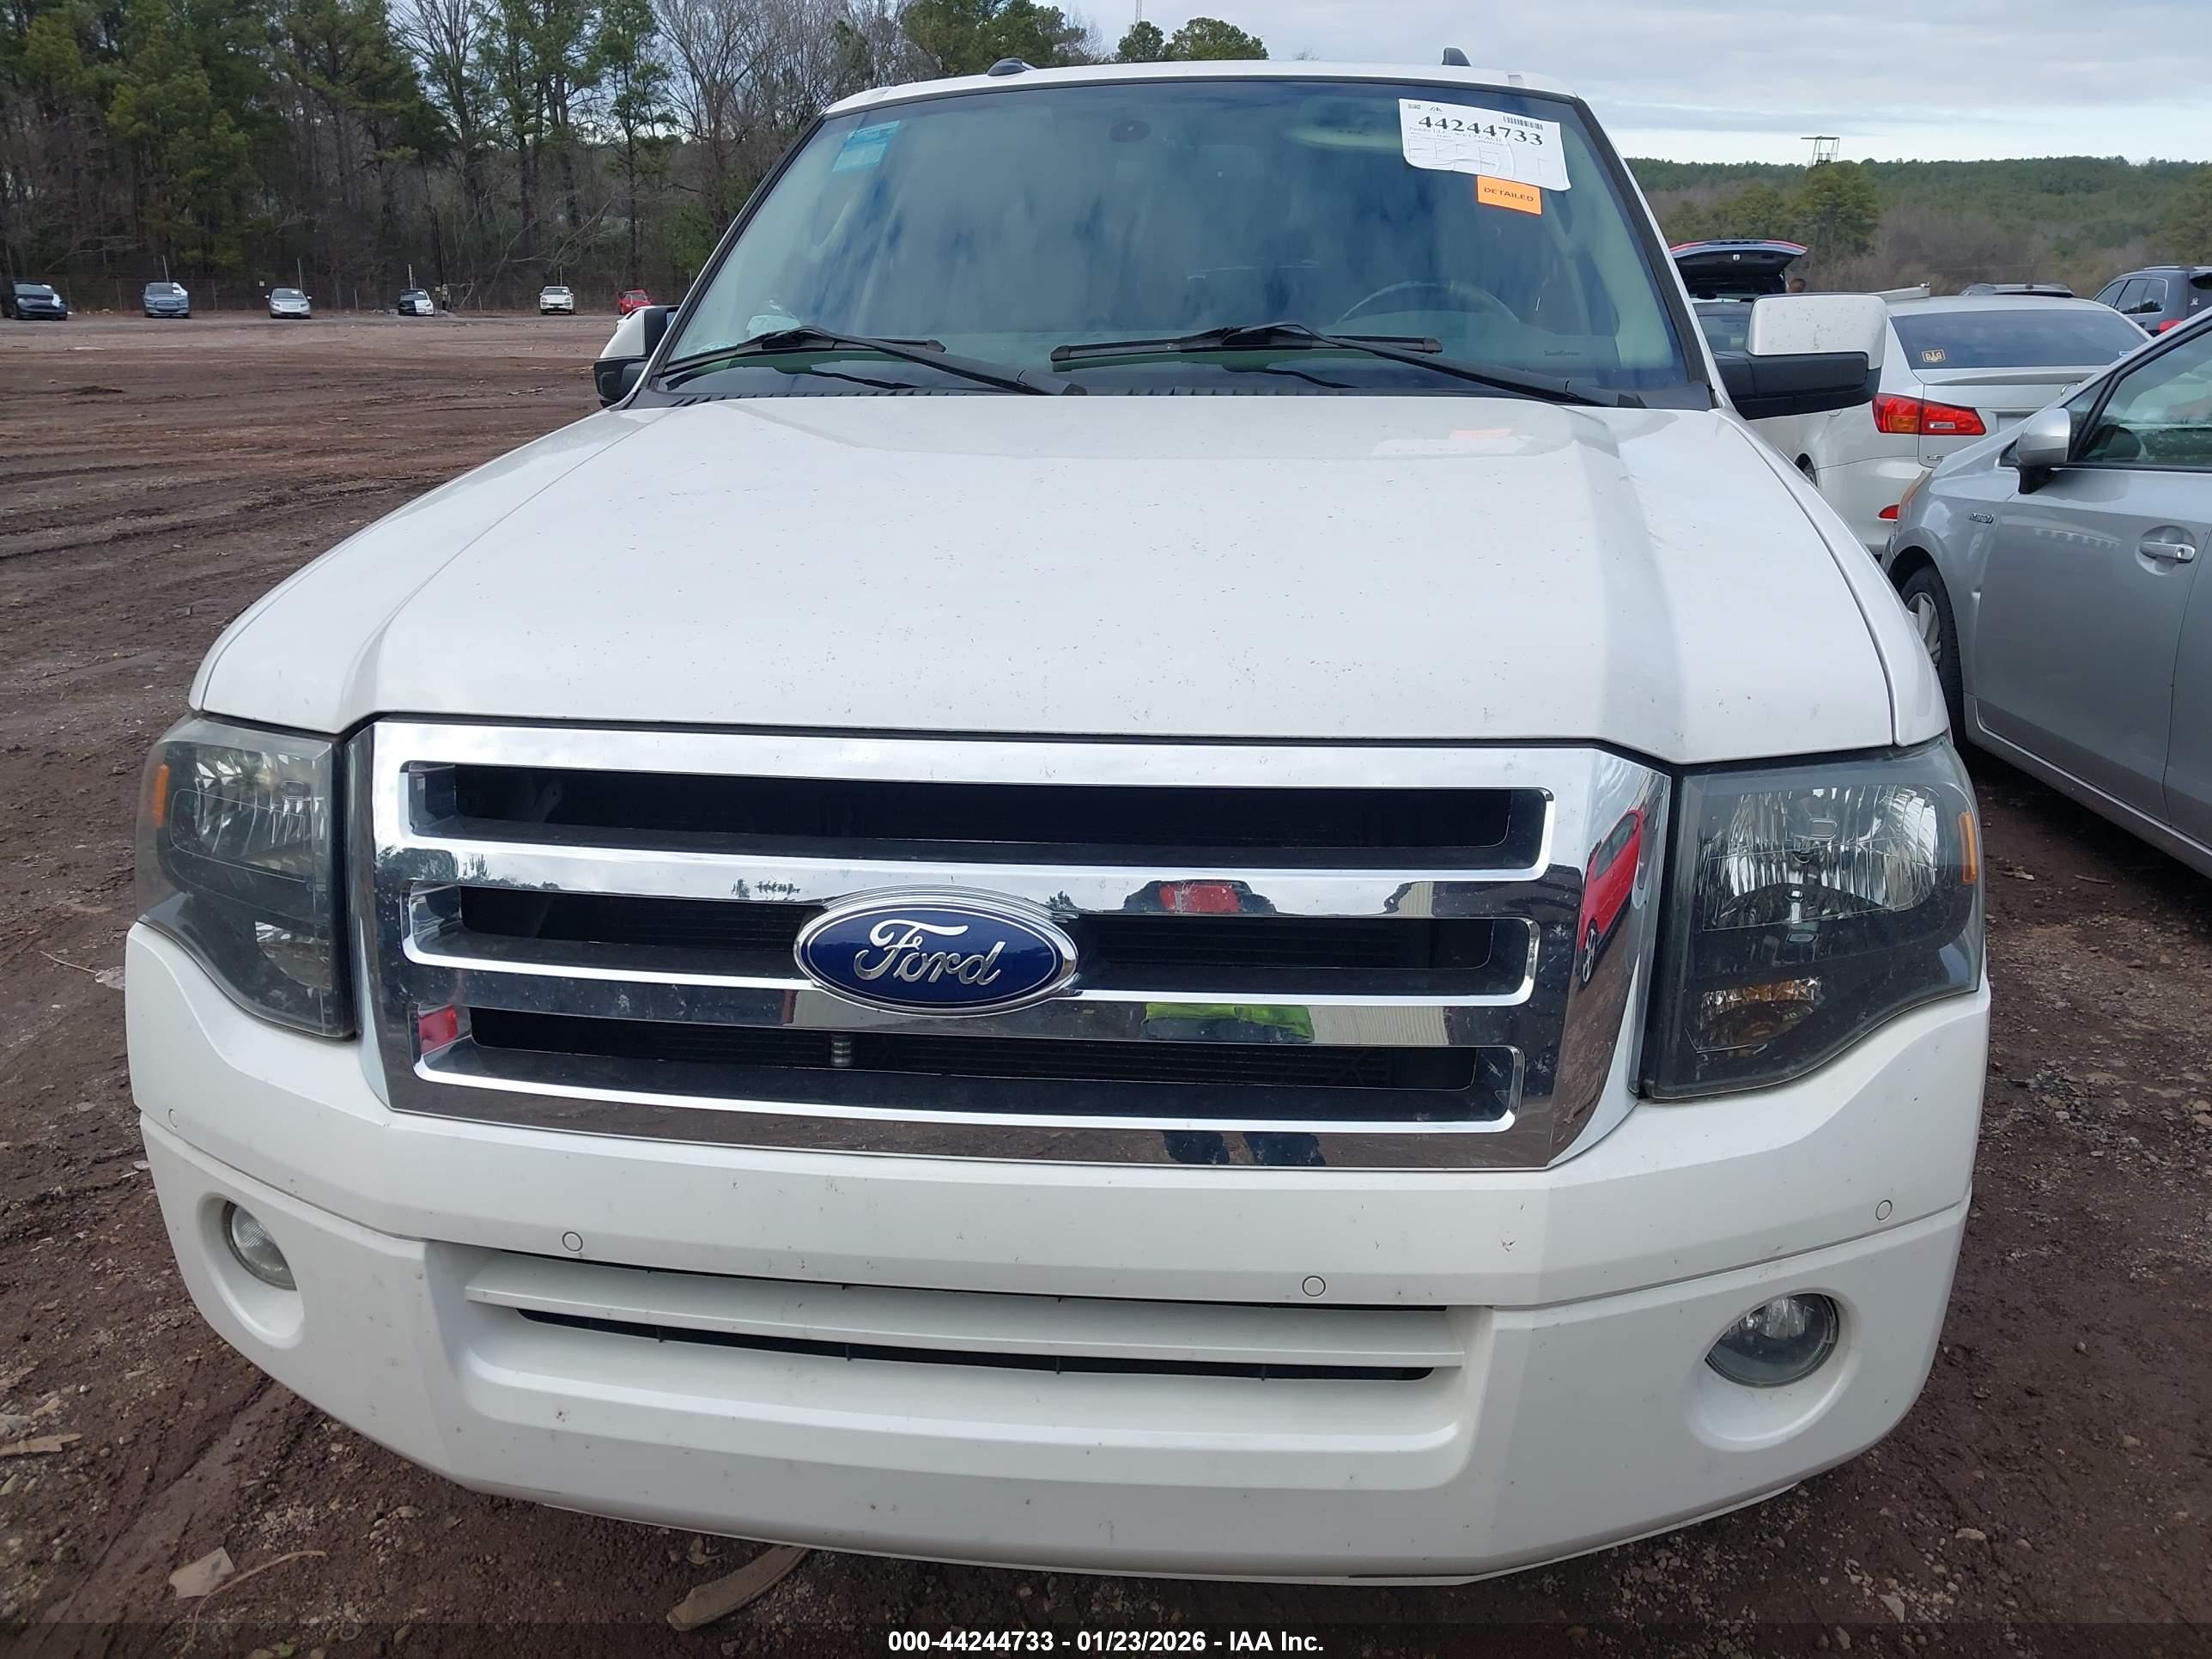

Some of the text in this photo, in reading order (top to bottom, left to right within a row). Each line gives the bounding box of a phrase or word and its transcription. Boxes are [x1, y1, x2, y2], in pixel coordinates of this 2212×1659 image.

[1419, 115, 1544, 146] 44244733
[1484, 186, 1534, 202] DETAILED
[854, 919, 1007, 986] Ford
